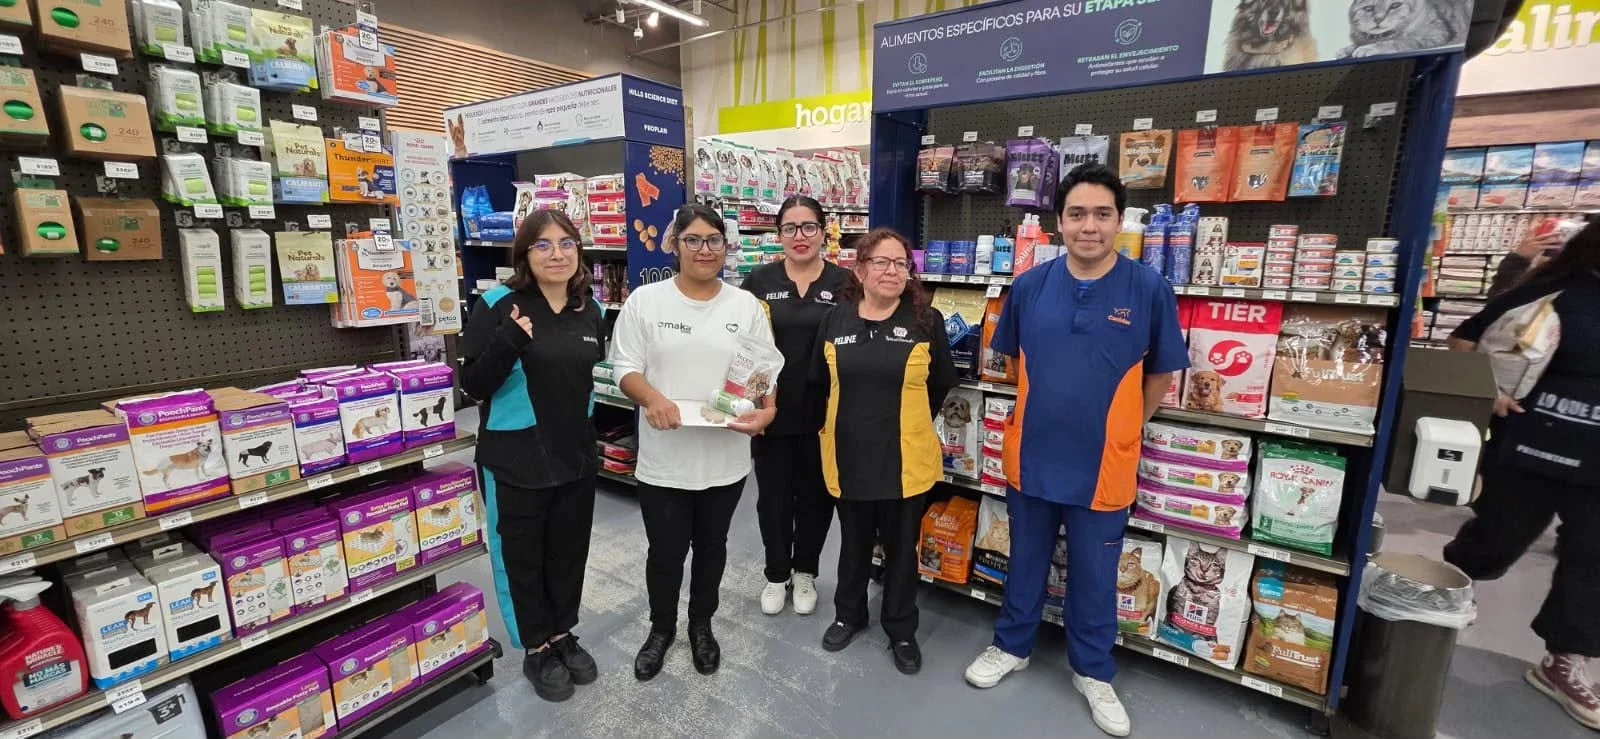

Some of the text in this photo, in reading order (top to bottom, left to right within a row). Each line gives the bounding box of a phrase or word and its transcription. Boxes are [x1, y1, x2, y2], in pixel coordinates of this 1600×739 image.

[880, 27, 944, 48] ALIMENTOS
[946, 13, 1023, 38] ESPECÍFICOS
[1026, 7, 1061, 24] PARA
[1063, 2, 1082, 17] SU
[1118, 44, 1179, 59] ENVEJECIMIENTO
[629, 88, 678, 106] HILLS SCIENCE DIET
[796, 101, 872, 132] hogar
[644, 124, 668, 134] PROPLAN
[286, 146, 320, 157] Naturals
[288, 252, 325, 262] Naturals
[766, 291, 790, 300] FELINE
[834, 334, 856, 345] FELINE
[158, 406, 208, 418] PoochPants
[1270, 470, 1298, 481] ROYAL
[171, 598, 192, 609] LEAK
[103, 620, 126, 634] LEAK
[26, 650, 63, 666] MIRACLE
[1262, 645, 1320, 662] FullTrust
[28, 662, 66, 680] NO MÁS
[30, 668, 66, 685] MARCAS
[159, 703, 176, 718] 3+
[266, 698, 292, 712] Reusable
